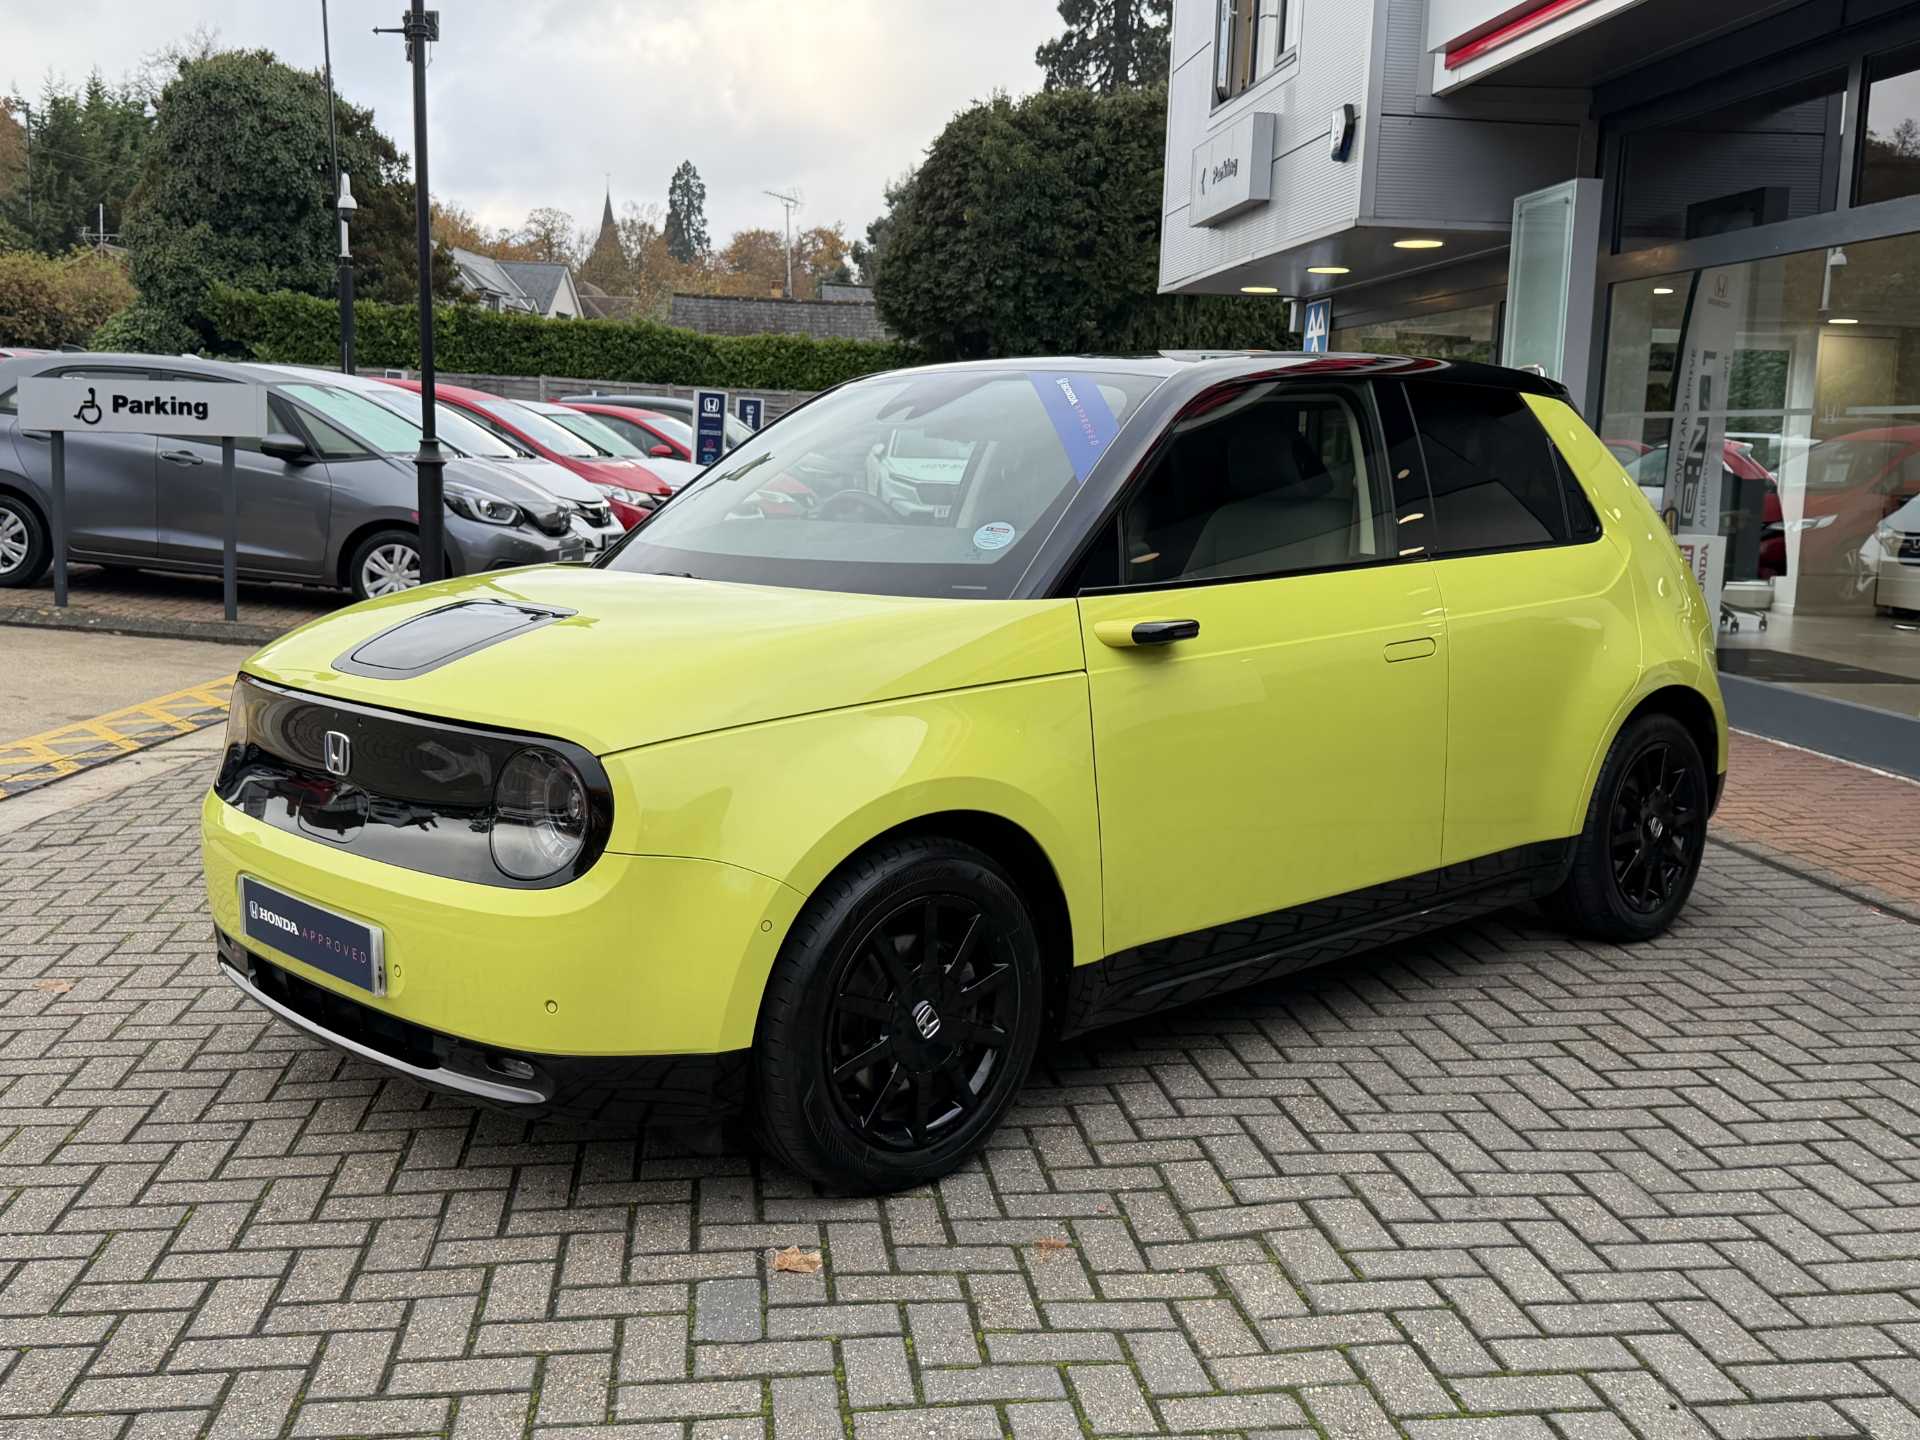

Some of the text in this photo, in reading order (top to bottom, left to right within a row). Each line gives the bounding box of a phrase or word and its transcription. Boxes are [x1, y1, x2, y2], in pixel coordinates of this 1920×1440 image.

[112, 394, 208, 420] Parking
[1697, 544, 1709, 593] ONDA
[258, 907, 368, 964] HONDA APPROVED
